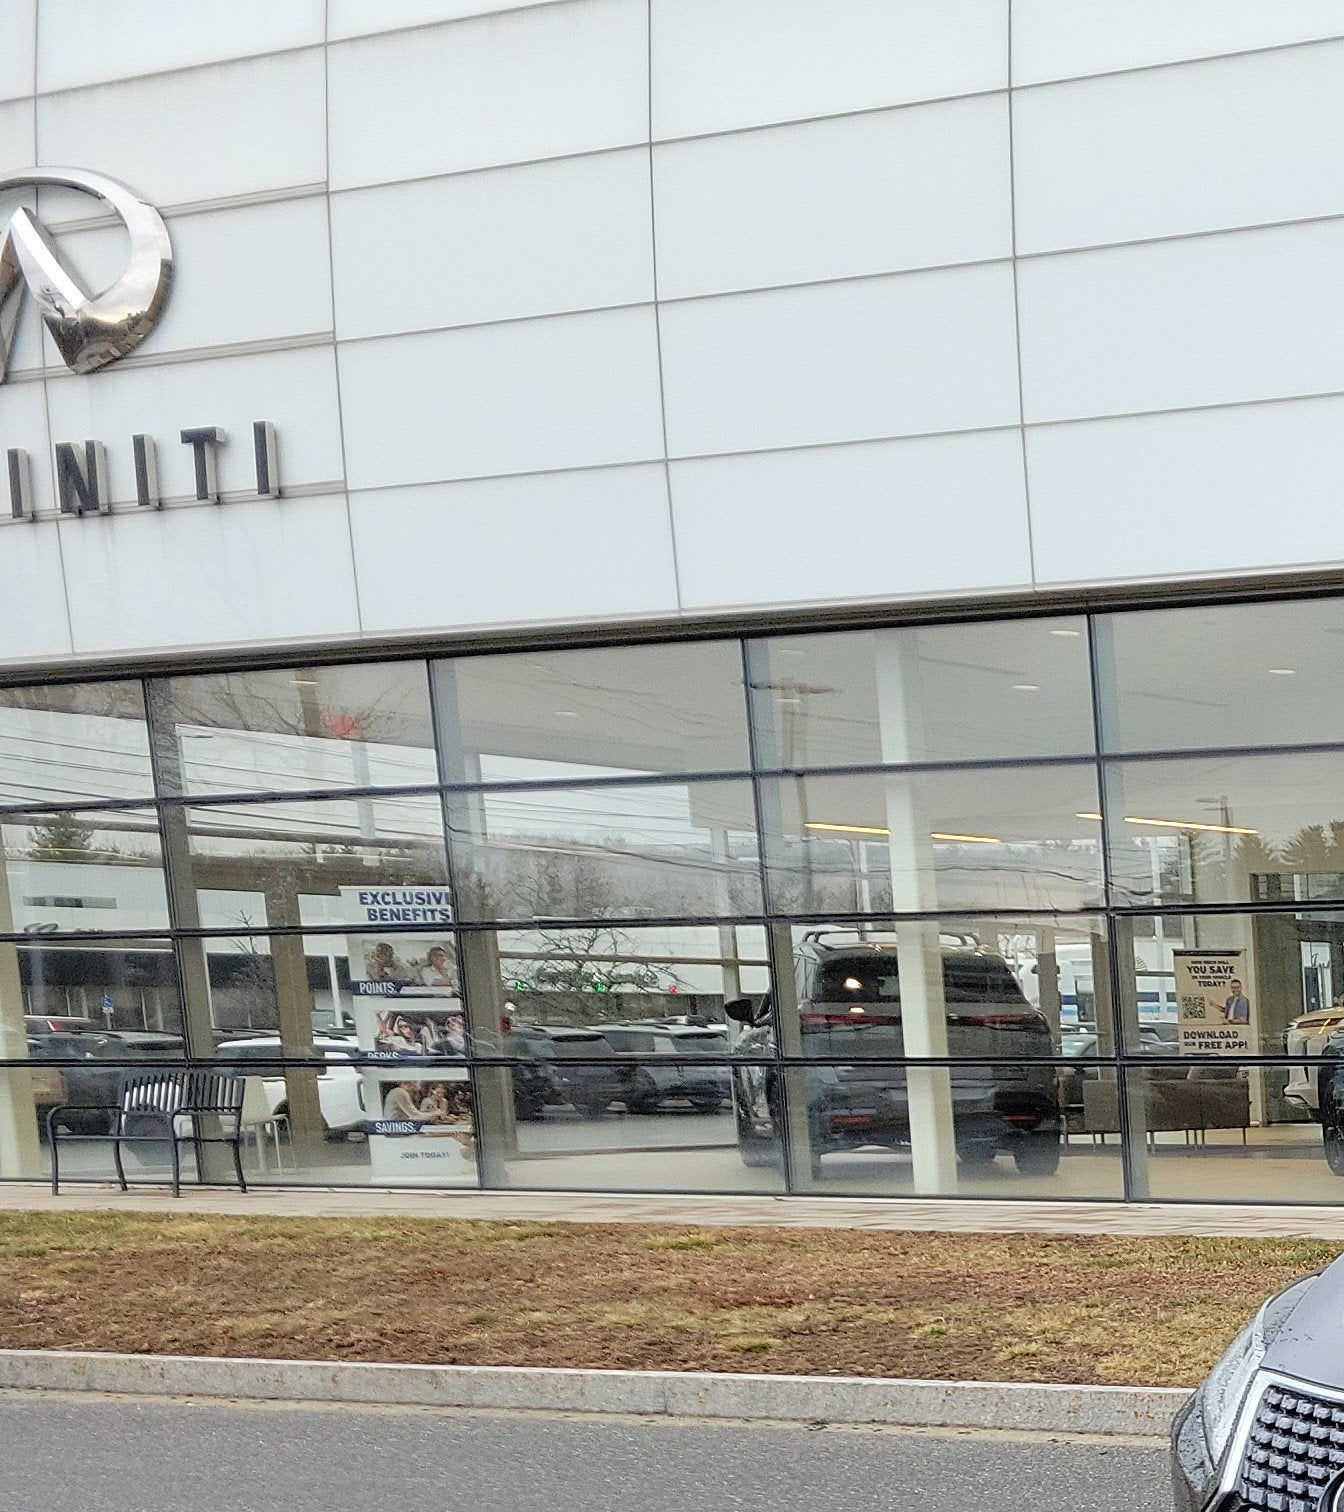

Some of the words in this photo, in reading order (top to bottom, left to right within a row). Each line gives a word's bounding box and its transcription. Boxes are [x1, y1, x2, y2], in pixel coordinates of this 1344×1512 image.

[366, 907, 451, 922] BENEFITS
[1186, 965, 1207, 974] YOU
[1209, 965, 1235, 974] SAVE
[1183, 1030, 1239, 1040] DOWNLOAD
[1198, 1041, 1222, 1049] FREE
[1224, 1040, 1248, 1050] APP!
